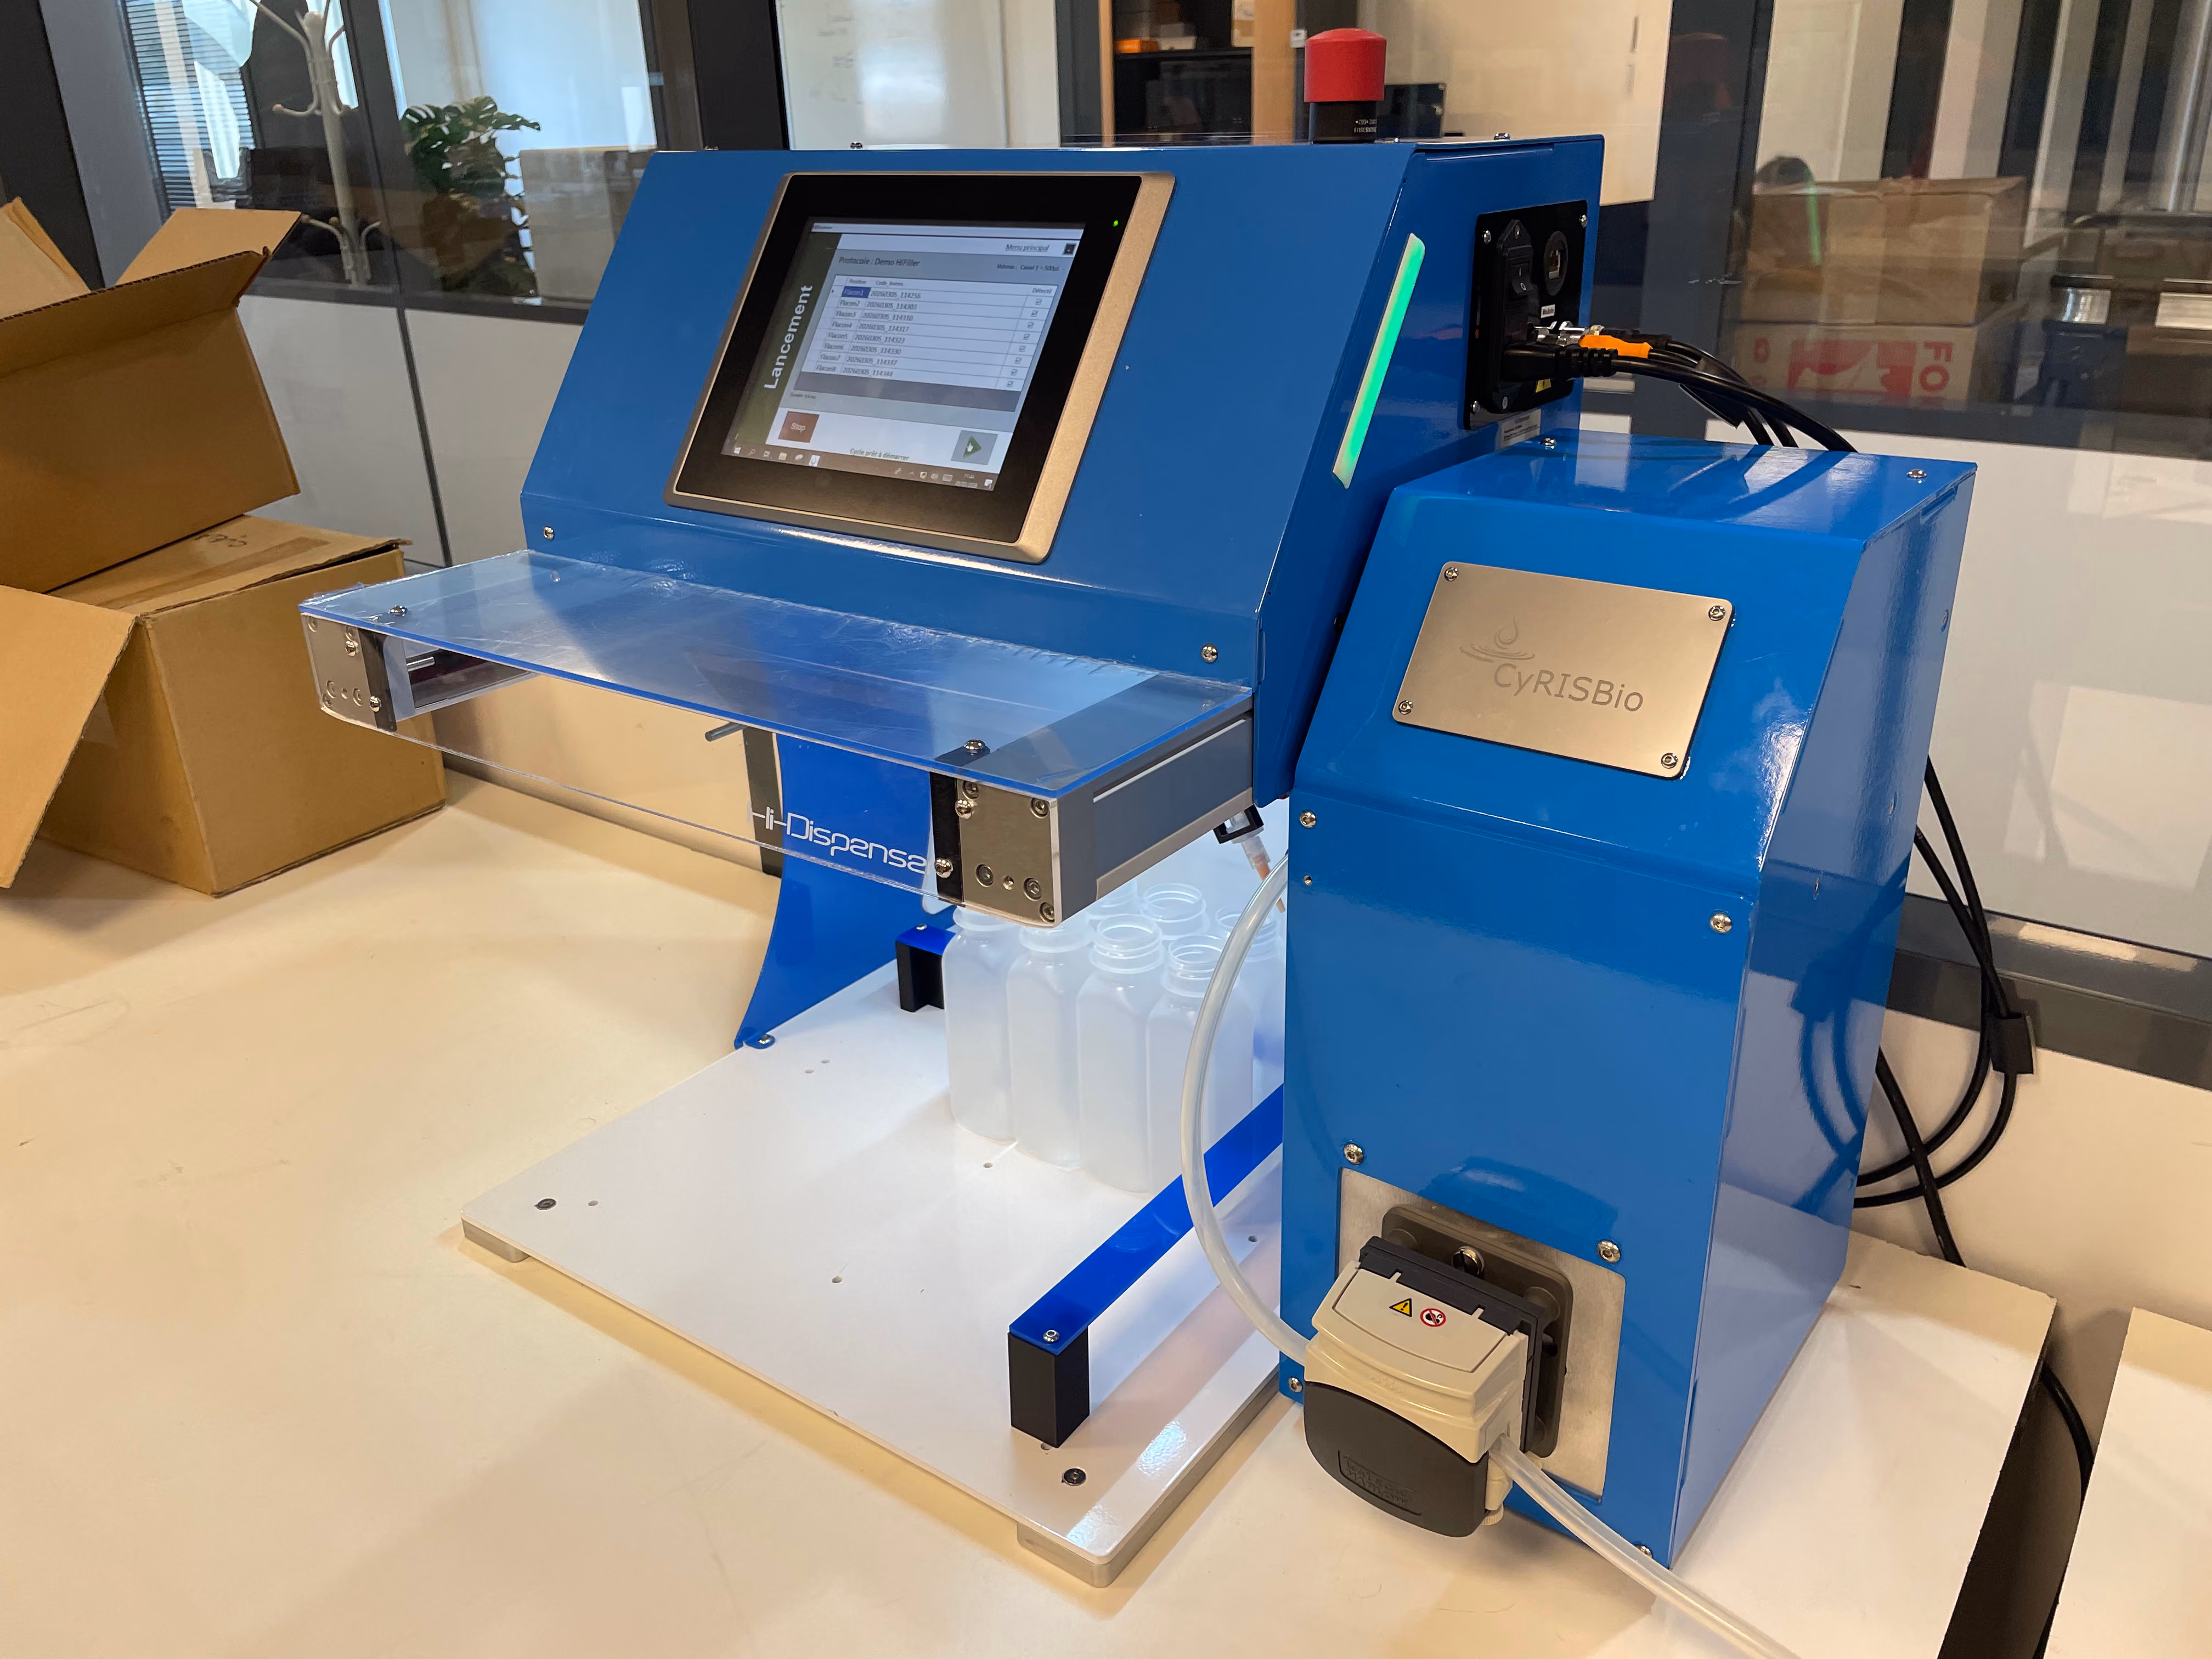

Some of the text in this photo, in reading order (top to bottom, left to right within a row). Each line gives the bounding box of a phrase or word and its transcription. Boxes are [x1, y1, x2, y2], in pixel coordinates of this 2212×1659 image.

[839, 256, 870, 265] Protocole
[874, 258, 895, 266] Demo
[764, 285, 812, 389] Lancement
[791, 422, 806, 433] Stop
[850, 448, 865, 456] Cycle
[865, 449, 878, 458] prêt
[883, 451, 910, 461] démarrer
[1493, 663, 1643, 712] CyRISBio
